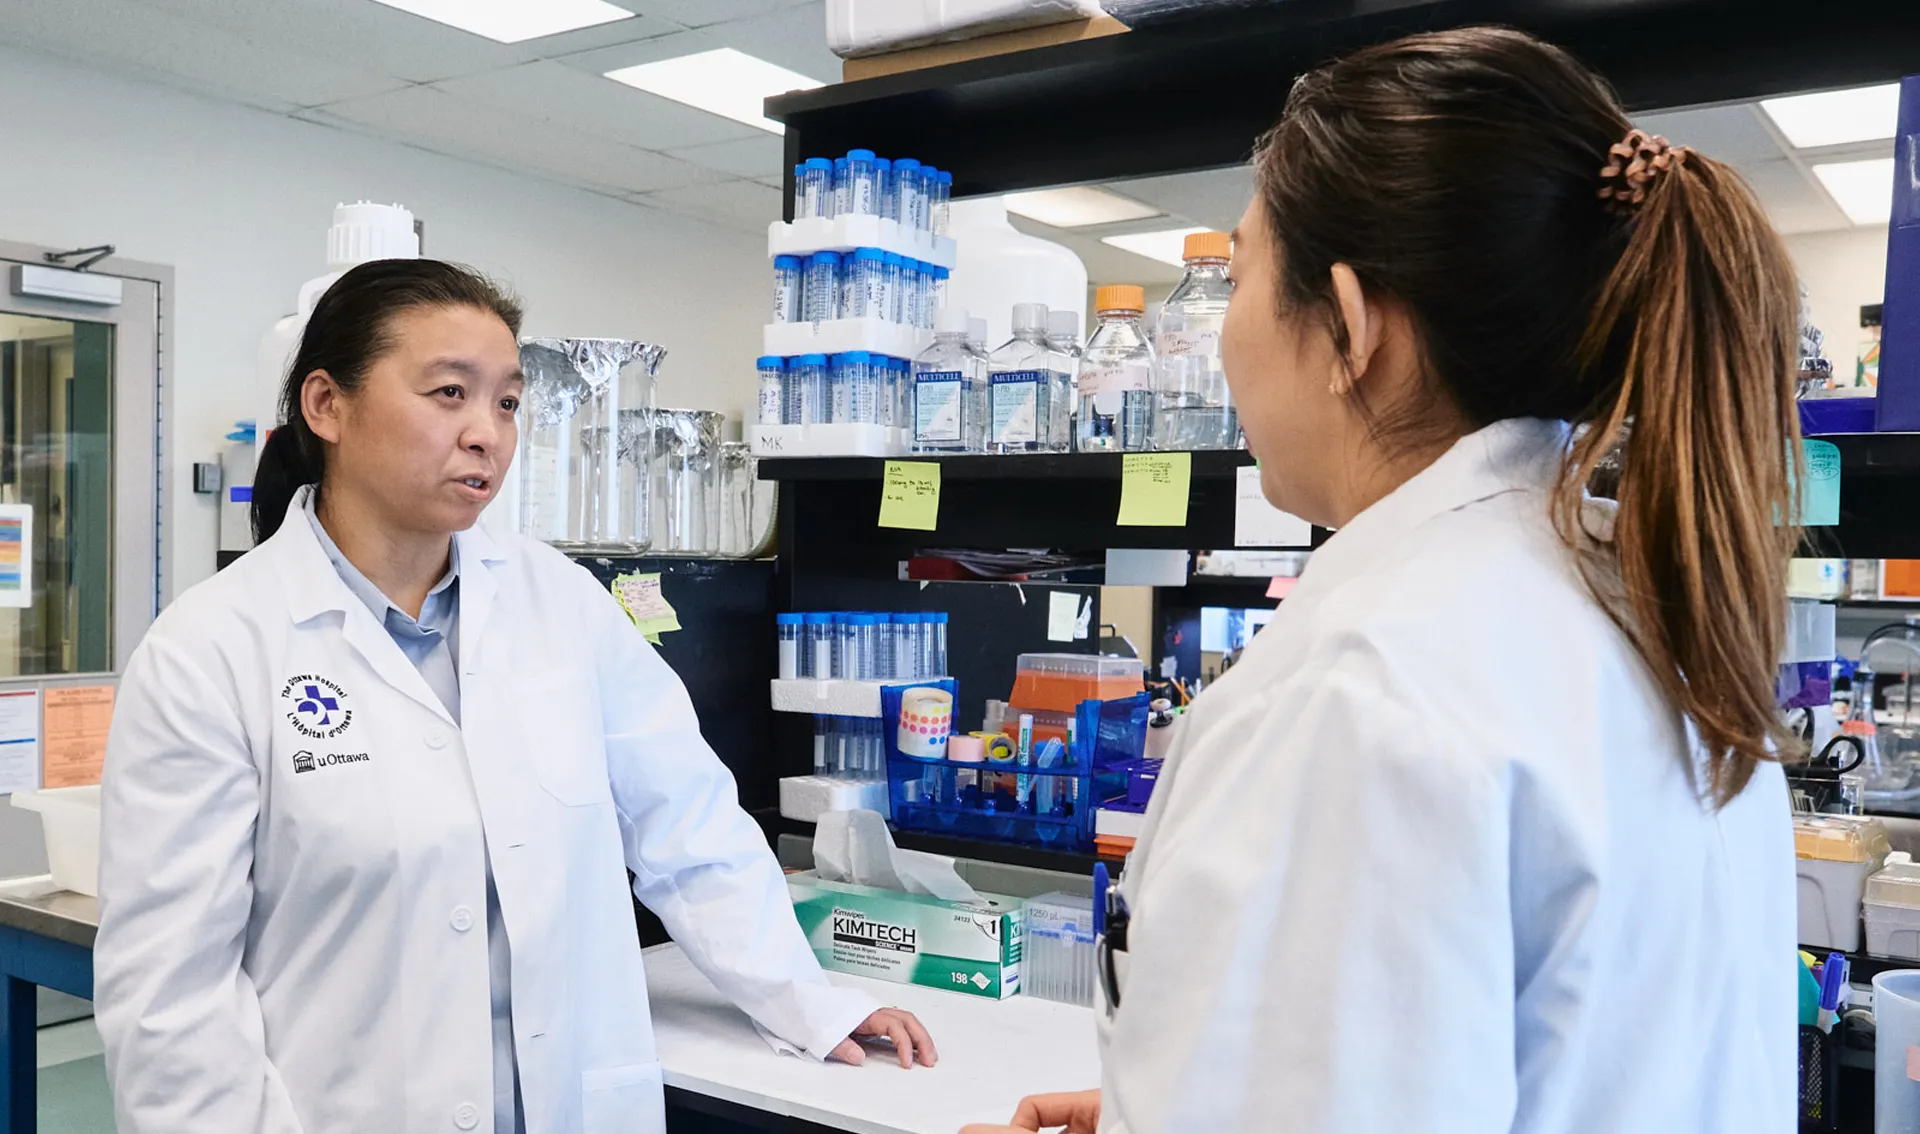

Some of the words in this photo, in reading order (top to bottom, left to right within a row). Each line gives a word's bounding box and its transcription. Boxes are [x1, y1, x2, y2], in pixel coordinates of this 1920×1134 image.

[918, 372, 960, 381] MULTICELL
[994, 373, 1035, 382] MULTICELL
[761, 436, 783, 450] MK
[281, 685, 292, 699] The
[287, 674, 312, 686] Ottawa
[315, 674, 348, 699] Hospital
[286, 712, 325, 739] L'Hôpital
[833, 908, 865, 919] Kimwipes
[1029, 908, 1048, 919] 1250
[833, 917, 916, 944] KIMTECH
[991, 920, 996, 934] 1
[951, 972, 968, 985] 198
